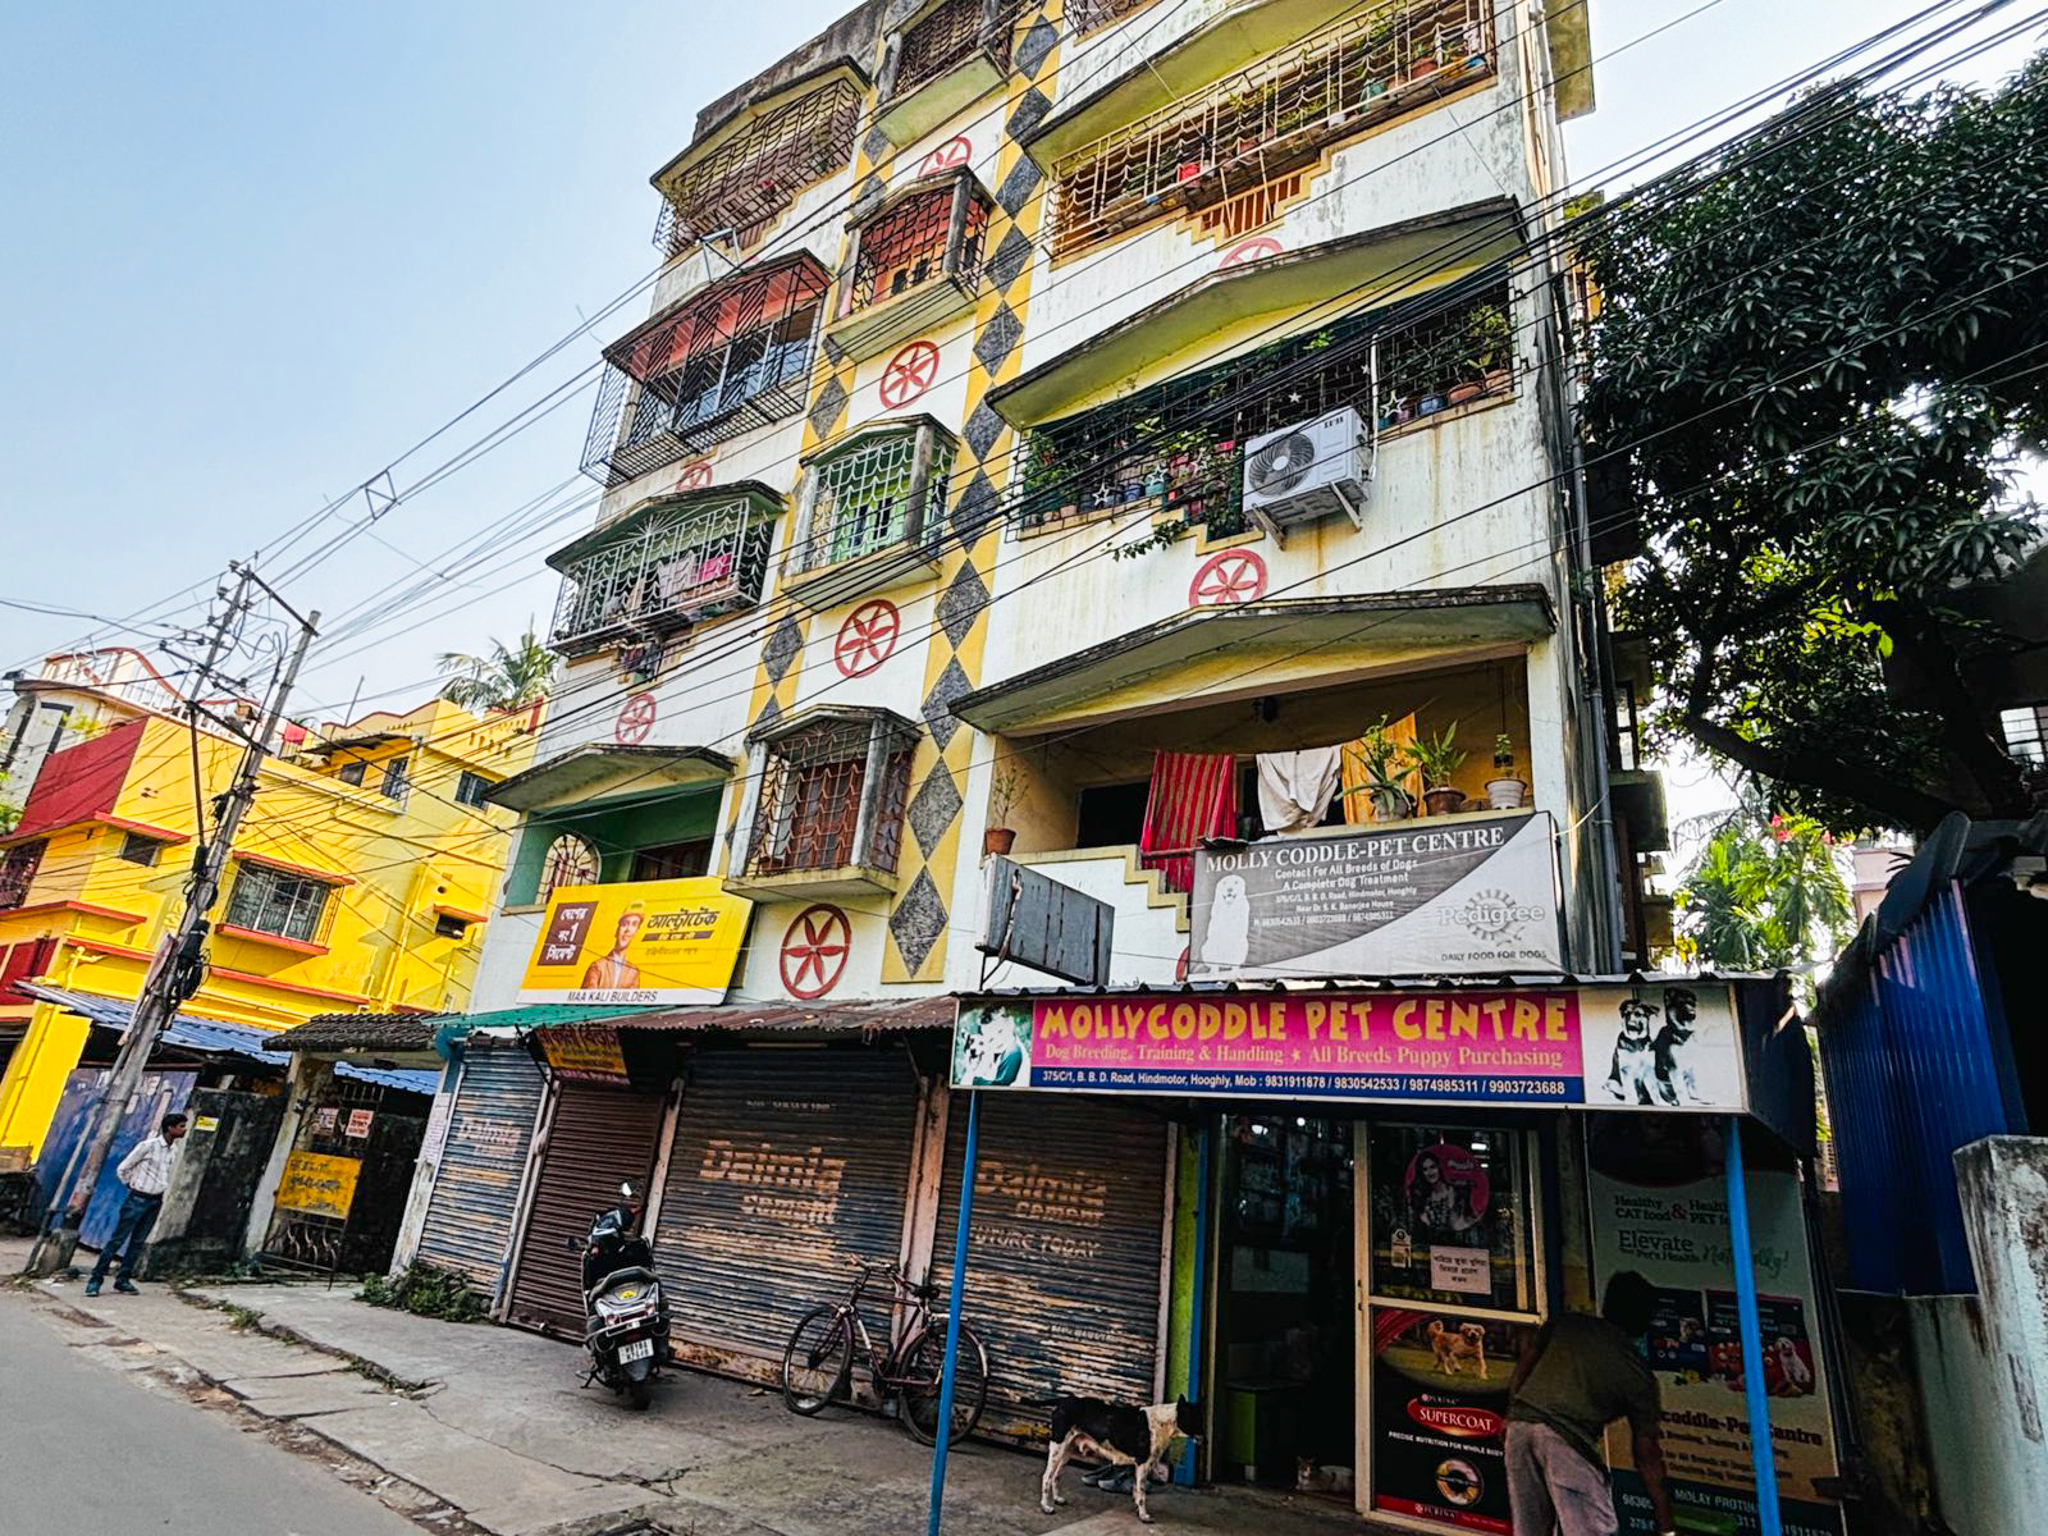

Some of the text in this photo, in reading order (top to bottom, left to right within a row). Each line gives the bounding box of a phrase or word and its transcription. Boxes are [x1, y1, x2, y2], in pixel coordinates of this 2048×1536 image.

[1206, 826, 1505, 873] MOLLY CODDLE-PET CENTRE
[1275, 859, 1418, 879] Contact For All Breeds of Dogs
[1283, 872, 1409, 891] A Complete Dog Treatment
[1439, 904, 1546, 928] Pedigree
[1441, 950, 1547, 961] DAILY FOOD FOR DOGS
[567, 991, 658, 1002] MAA KALI BUILDERS
[1040, 998, 1568, 1042] MOLLYCODDLE PET CENTRE
[1045, 1044, 1070, 1061] Dog
[1137, 1044, 1195, 1064] Training
[1199, 1045, 1211, 1061] &
[1217, 1045, 1285, 1065] Handling
[1310, 1046, 1331, 1063] All
[1337, 1046, 1392, 1064] Breeds
[1398, 1047, 1452, 1069] Puppy
[1457, 1047, 1563, 1070] Purchasing
[1042, 1070, 1075, 1083] 375/C/1,
[1077, 1071, 1086, 1082] B.
[1088, 1071, 1098, 1082] B.
[1099, 1072, 1109, 1083] D.
[1110, 1072, 1136, 1084] Road,
[1138, 1073, 1189, 1087] Hindmotor,
[1190, 1074, 1233, 1088] Hooghly,
[1235, 1075, 1257, 1087] Mob
[1265, 1075, 1326, 1088] 9831911878
[1334, 1077, 1400, 1090] 9830542533
[1410, 1078, 1478, 1092] 9874985311
[1489, 1080, 1566, 1094] 9903723688
[1615, 1207, 1642, 1220] CAT
[1643, 1209, 1671, 1221] food
[1617, 1229, 1694, 1252] Elevate
[1419, 1408, 1494, 1432] SUPERCOAT
[1415, 1435, 1449, 1448] NUTRITION
